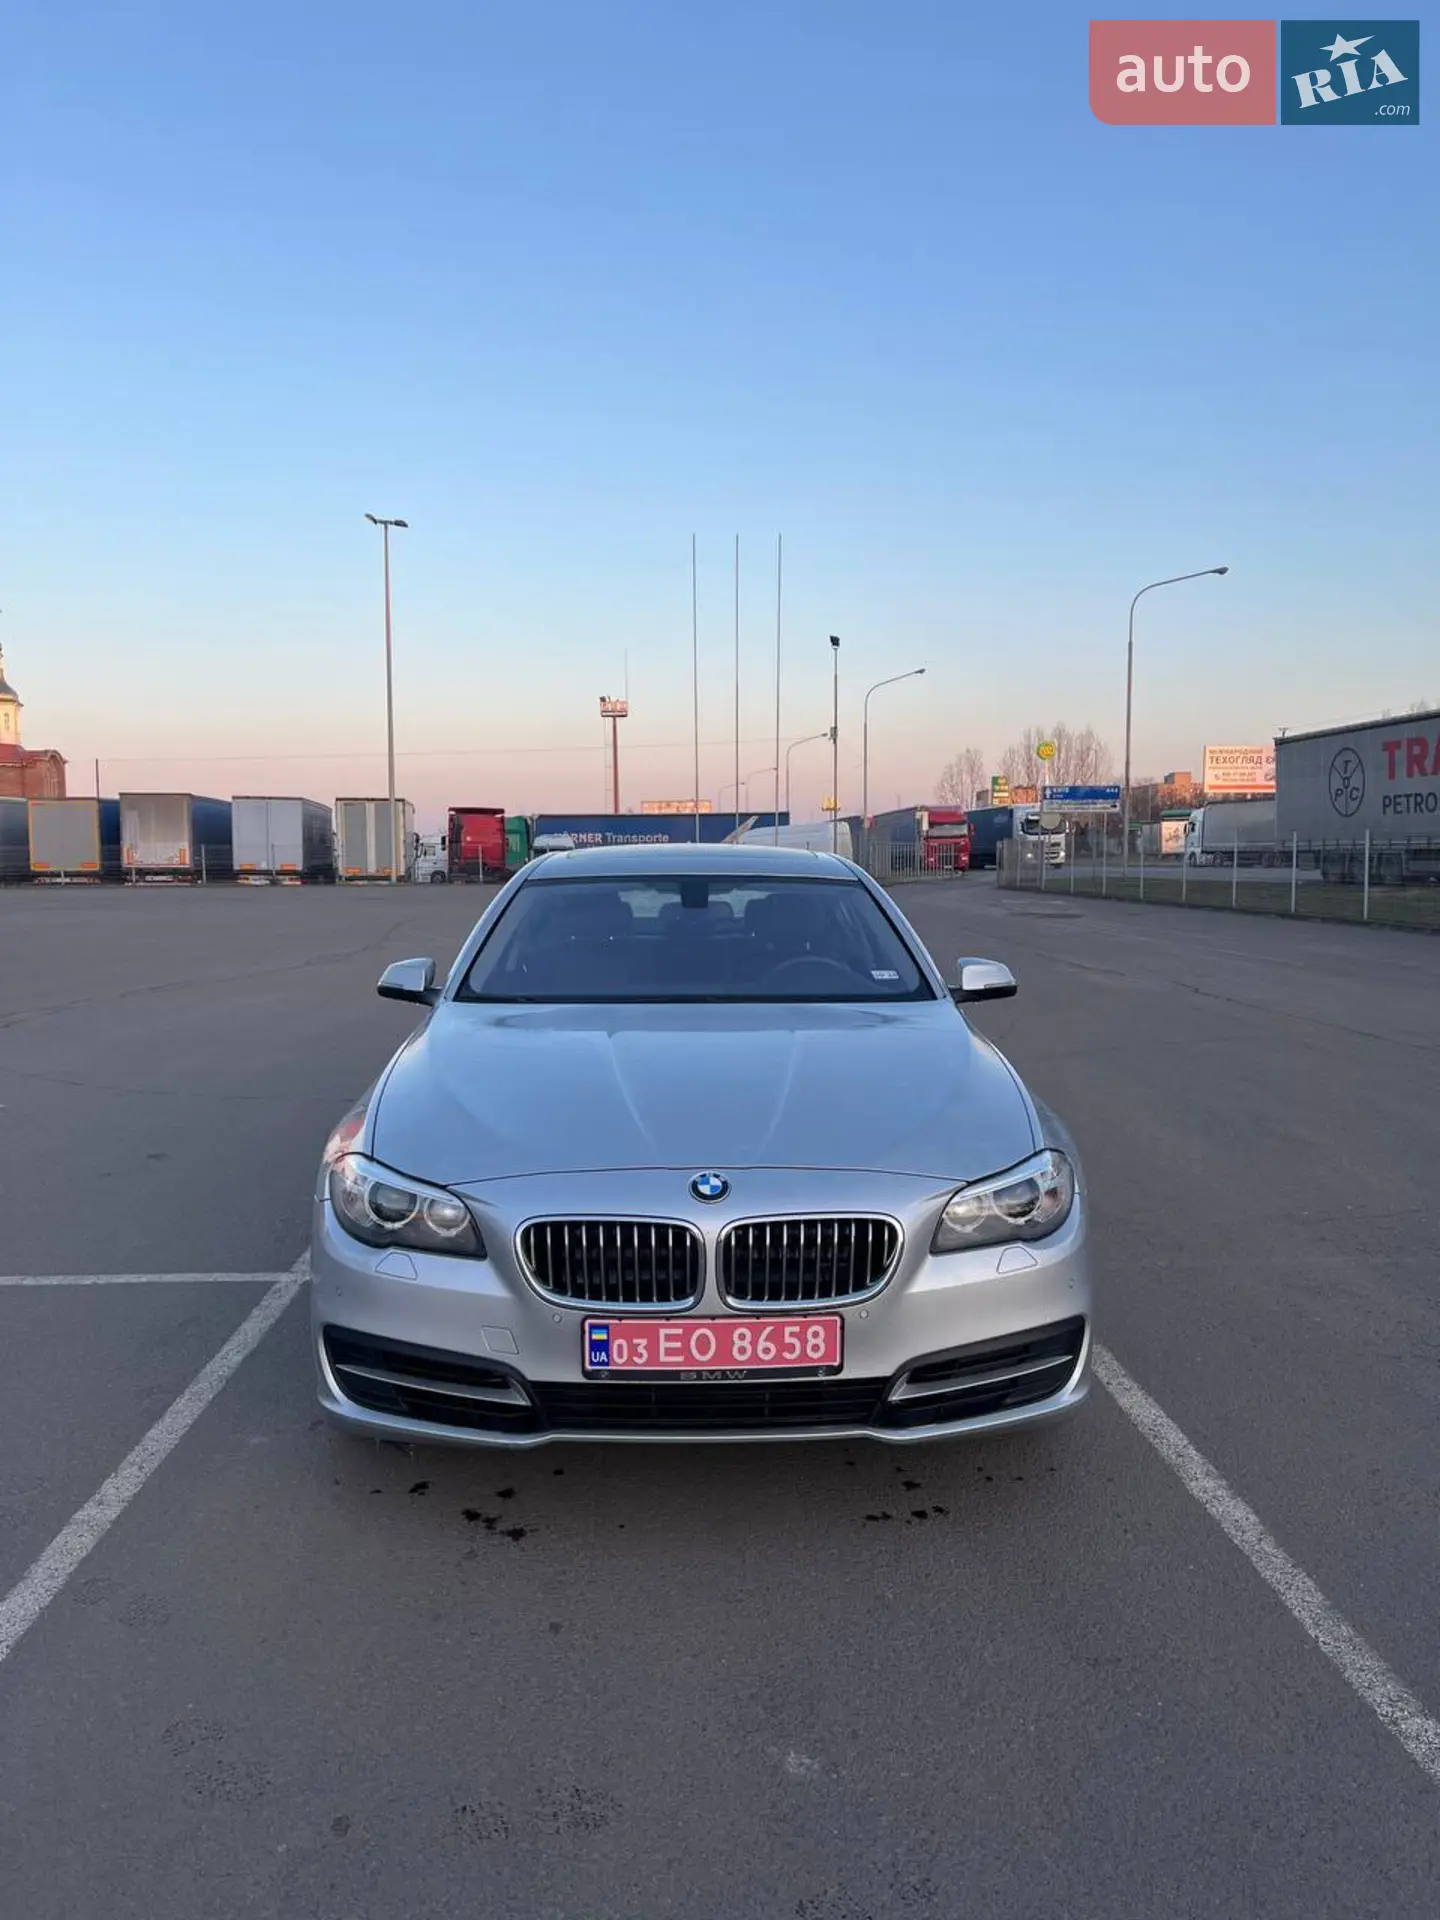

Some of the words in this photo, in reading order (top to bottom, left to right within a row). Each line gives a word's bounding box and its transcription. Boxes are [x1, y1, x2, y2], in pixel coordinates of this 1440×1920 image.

[1209, 755, 1263, 765] ТЕХОГЛЯД
[1382, 792, 1440, 816] PETRO
[606, 832, 670, 844] Transporte
[591, 1350, 608, 1364] UA
[612, 1338, 648, 1365] 03
[659, 1327, 716, 1363] EO
[732, 1325, 826, 1362] 8658
[680, 1370, 748, 1381] BMW
